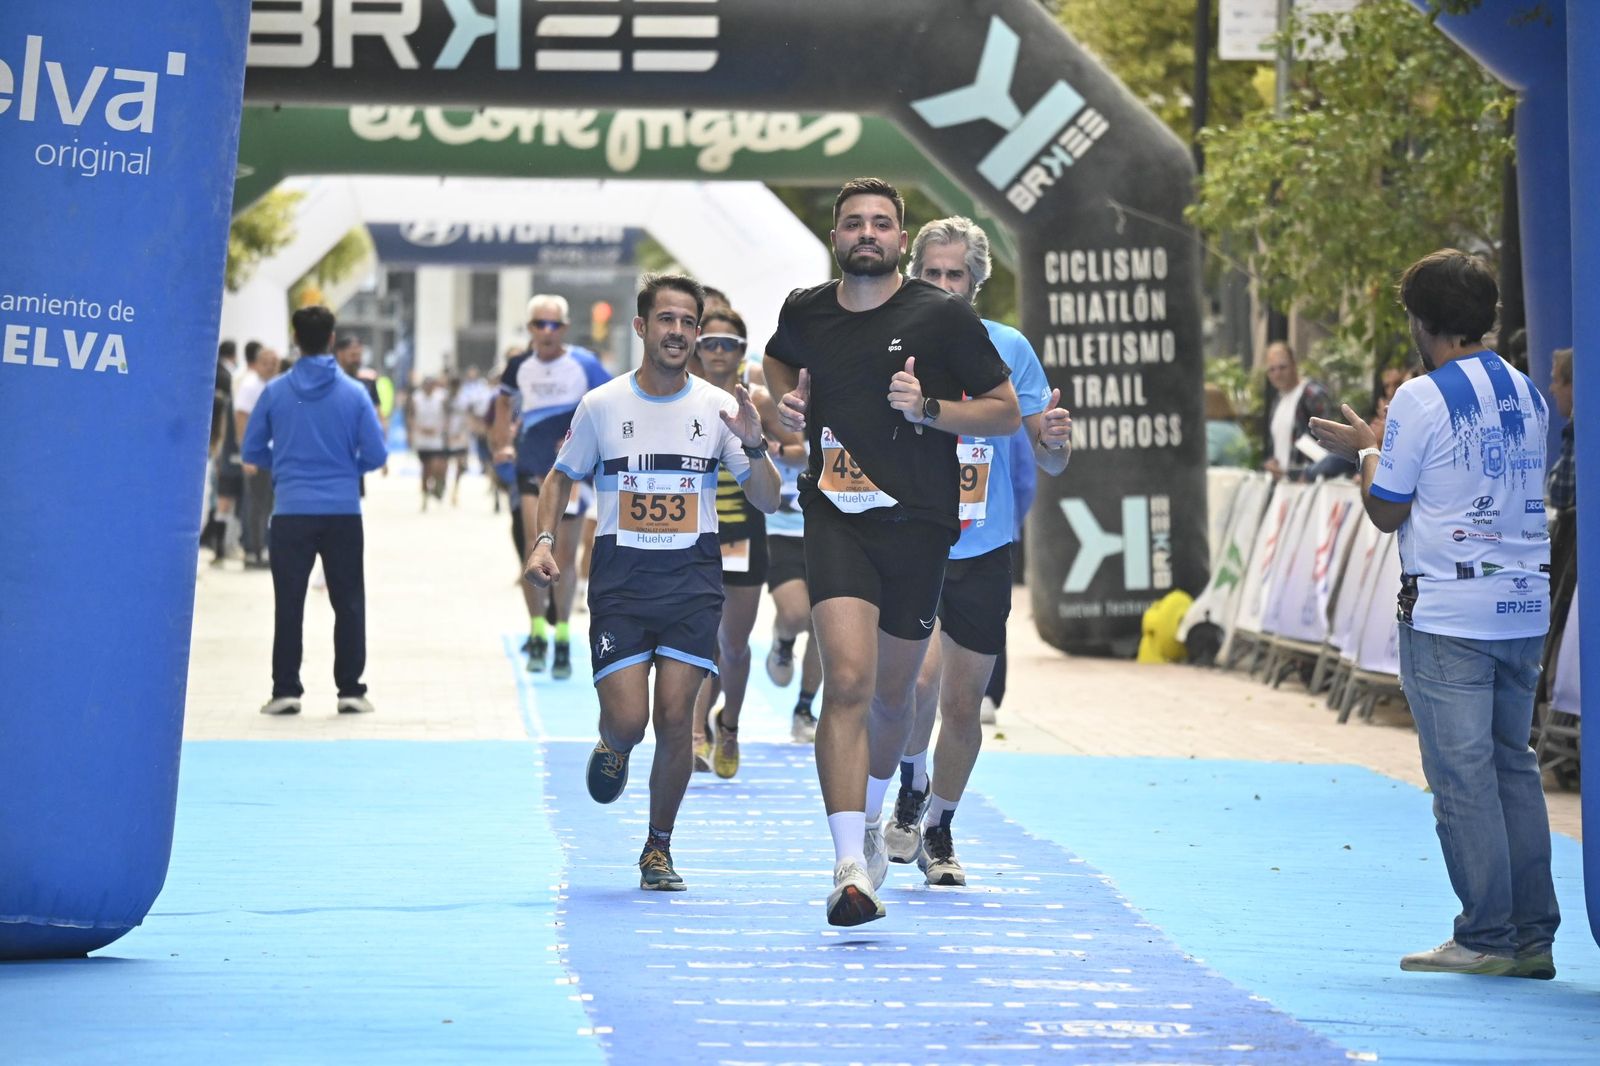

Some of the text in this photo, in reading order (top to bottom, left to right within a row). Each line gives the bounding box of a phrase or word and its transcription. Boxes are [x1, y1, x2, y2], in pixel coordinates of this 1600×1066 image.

[35, 138, 151, 177] original
[1044, 246, 1168, 285] CICLISMO
[108, 299, 135, 322] de
[1048, 284, 1167, 325] TRIATLÓN
[3, 324, 129, 374] ELVA
[1043, 329, 1176, 368] ATLETISMO
[1072, 374, 1147, 408] TRAIL
[972, 447, 988, 459] 2K
[623, 475, 696, 489] 2K 2K
[630, 494, 686, 521] 553
[837, 492, 876, 503] Huelva
[637, 533, 673, 544] Huelva
